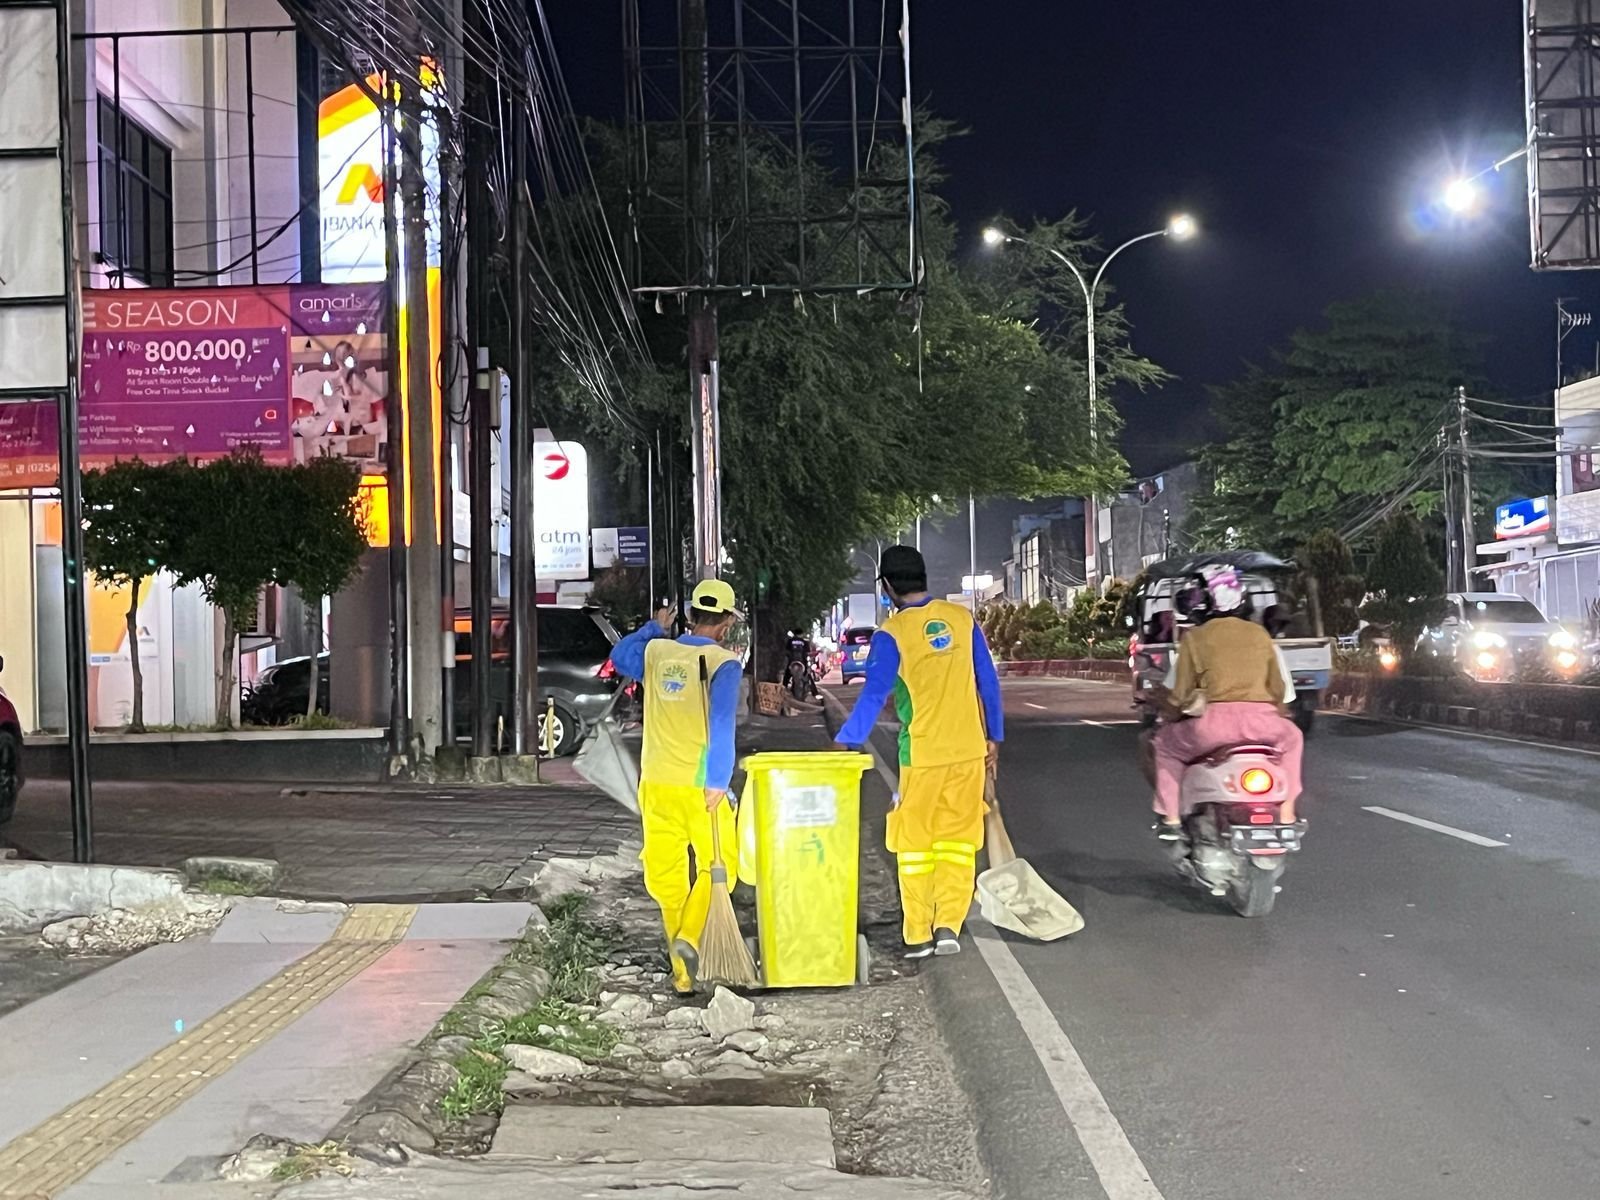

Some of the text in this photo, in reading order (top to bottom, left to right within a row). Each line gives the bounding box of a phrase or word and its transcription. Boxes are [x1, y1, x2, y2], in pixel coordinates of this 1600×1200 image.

[300, 293, 362, 310] amaris
[106, 299, 237, 328] SEASON
[540, 529, 581, 544] atm
